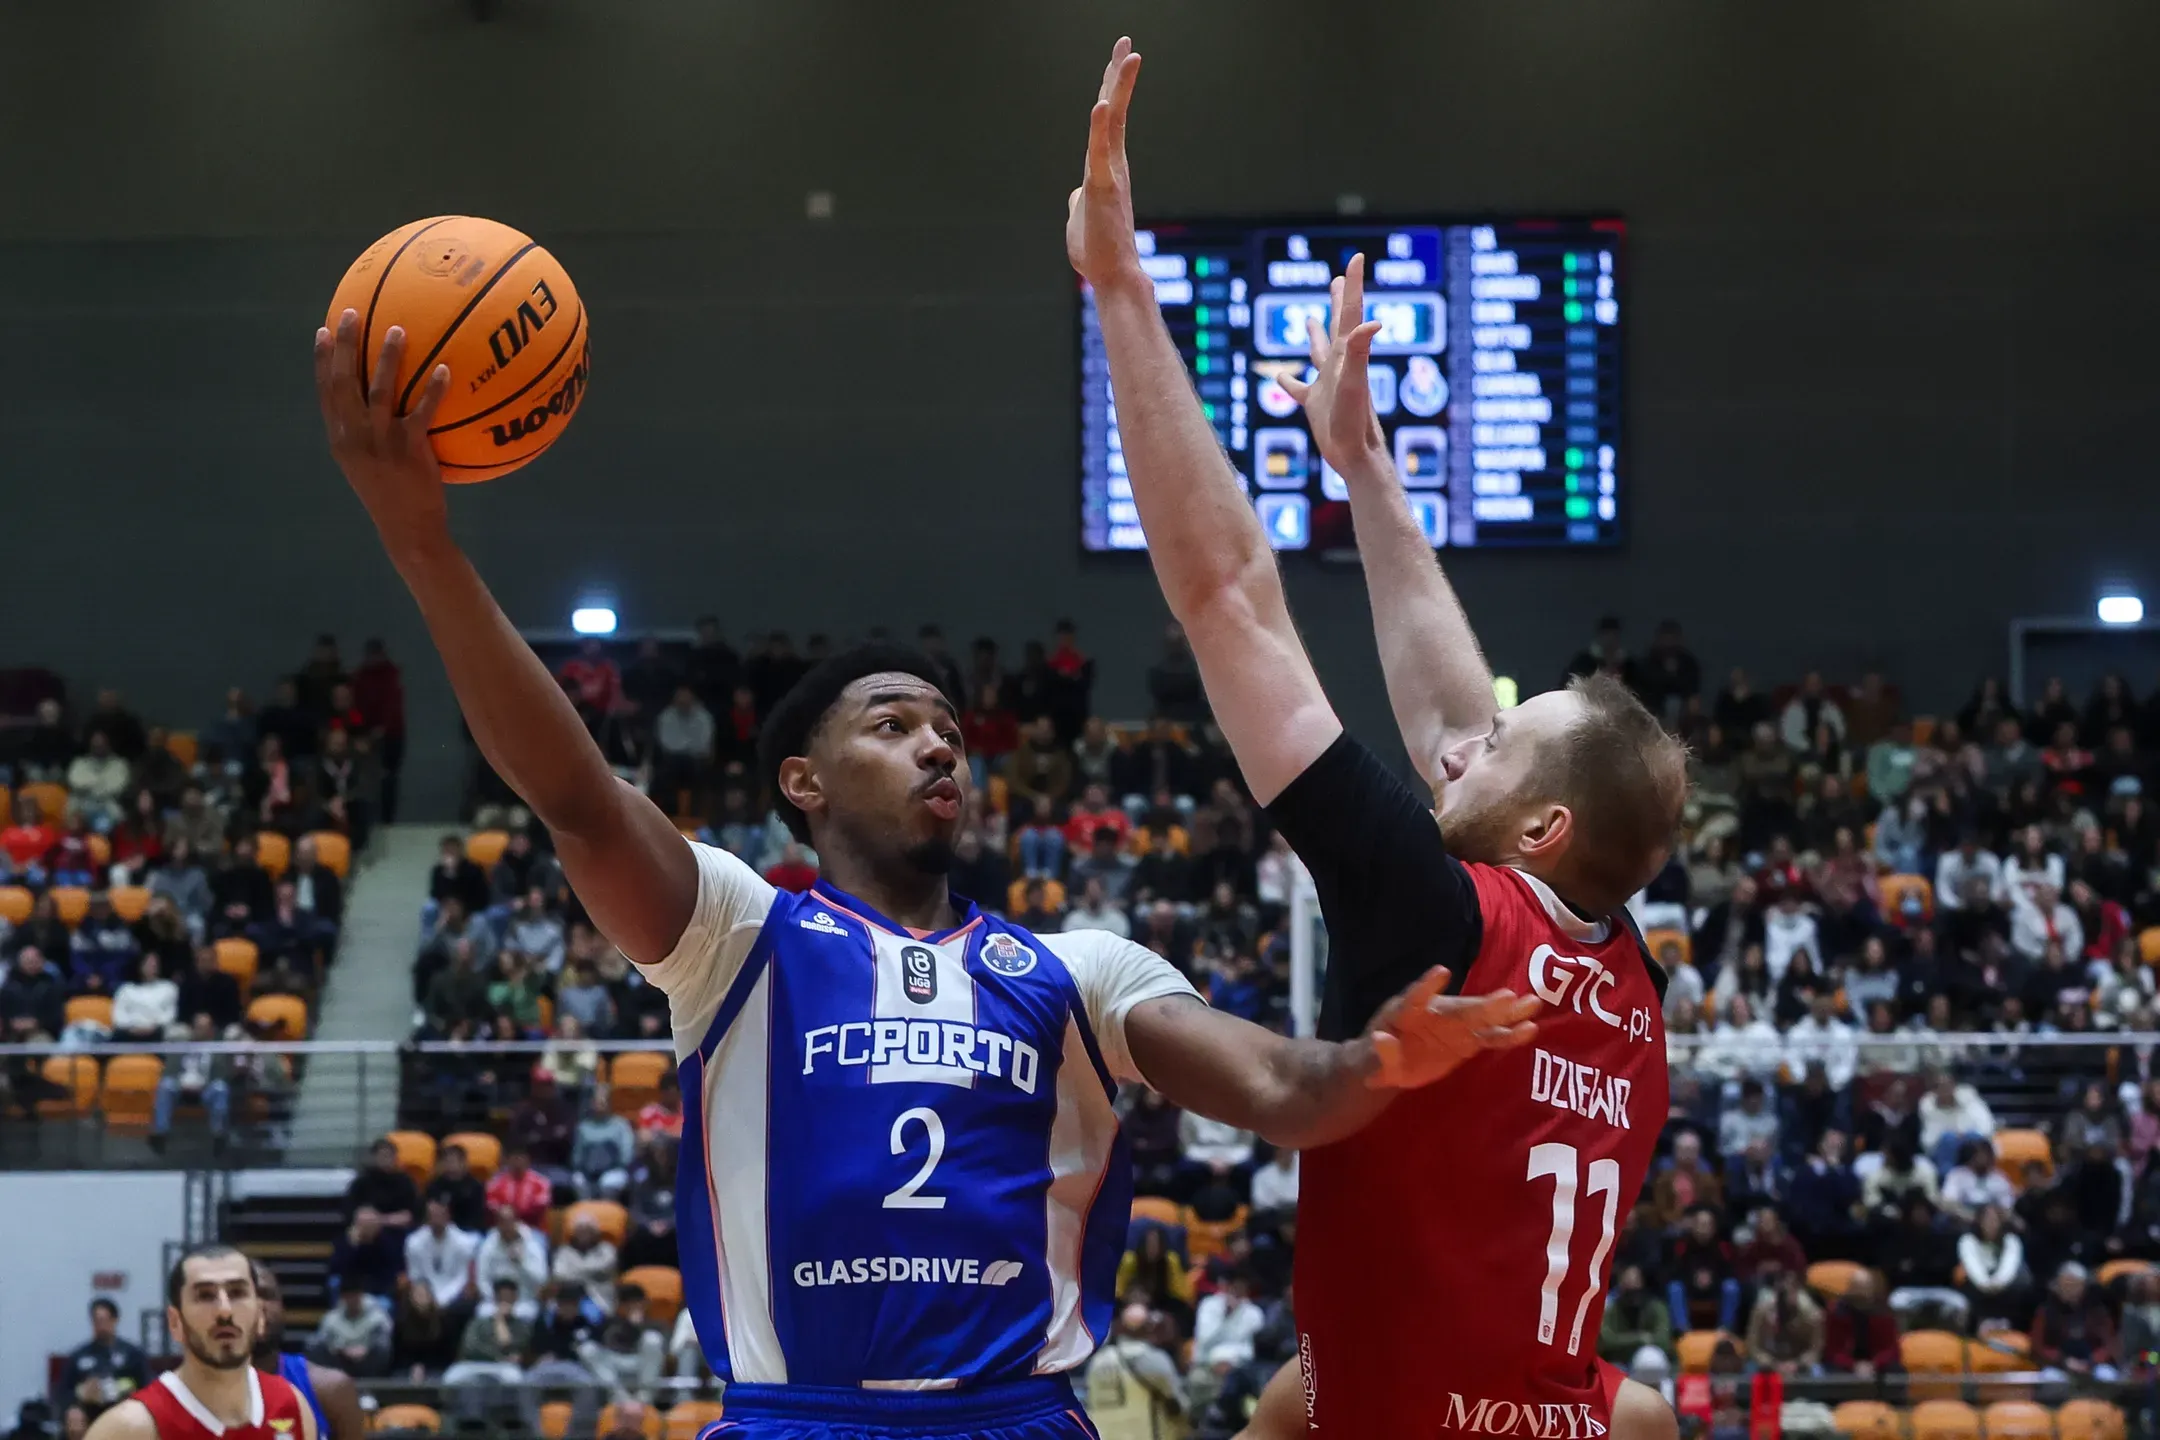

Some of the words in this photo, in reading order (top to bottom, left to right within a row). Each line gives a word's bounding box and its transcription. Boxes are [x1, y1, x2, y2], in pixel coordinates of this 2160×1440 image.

[489, 278, 558, 369] EVO
[1528, 943, 1652, 1043] GTC.pt
[1530, 1048, 1631, 1130] DZIEWA
[882, 1106, 947, 1209] 2
[793, 1256, 980, 1287] GLASSDRIVE
